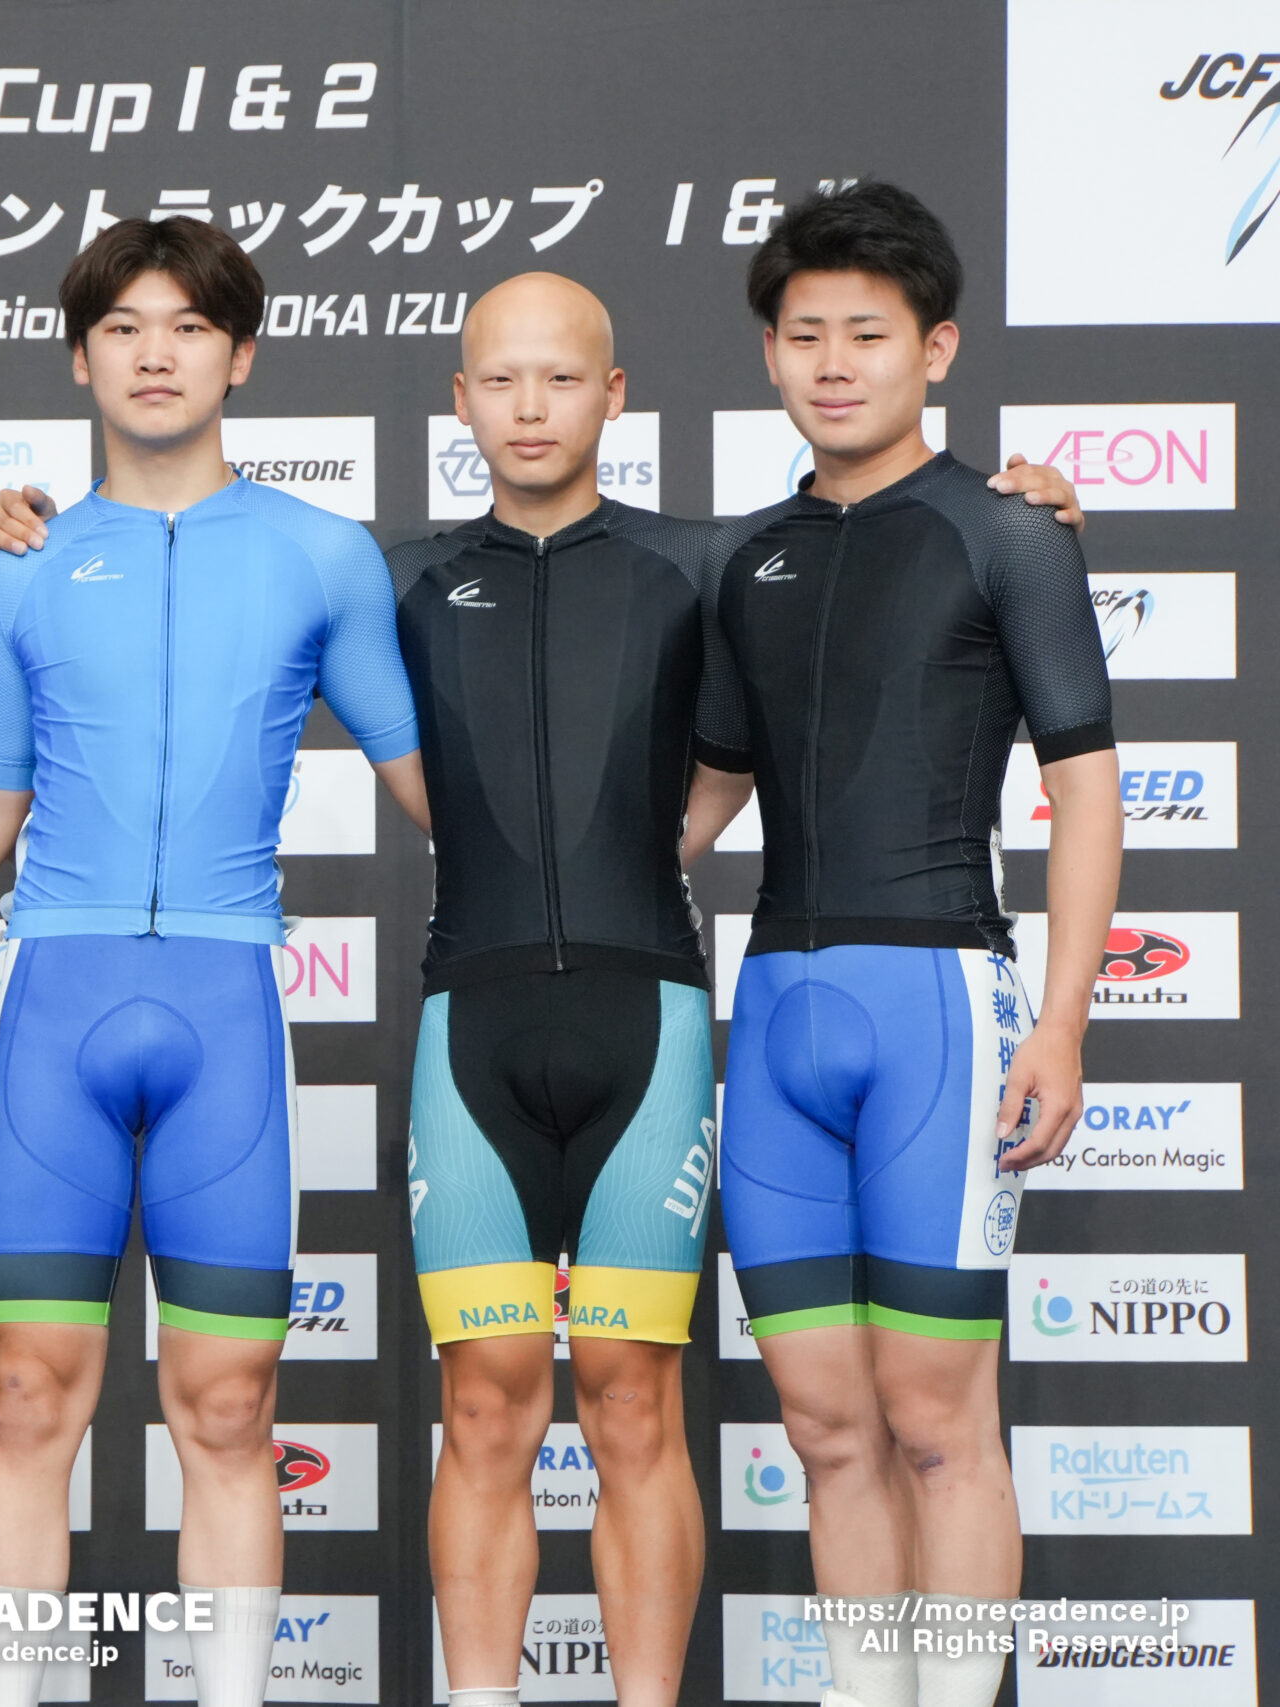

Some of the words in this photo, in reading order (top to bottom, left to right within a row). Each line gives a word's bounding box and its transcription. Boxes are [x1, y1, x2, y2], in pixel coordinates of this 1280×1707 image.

[228, 64, 291, 131] &
[315, 62, 378, 129] 2
[722, 178, 784, 245] &
[385, 292, 467, 335] IZU
[1082, 1148, 1156, 1168] Carbon
[1164, 1148, 1226, 1173] Magic
[1108, 1278, 1210, 1295] この道の先に
[459, 1302, 540, 1330] NARA
[570, 1306, 630, 1330] NARA
[1089, 1301, 1231, 1336] NIPPO
[1049, 1442, 1189, 1475] Rakuten
[1050, 1490, 1214, 1521] Kドリームス
[1035, 1641, 1236, 1668] BRIDGESTONE
[301, 1660, 363, 1682] Magic
